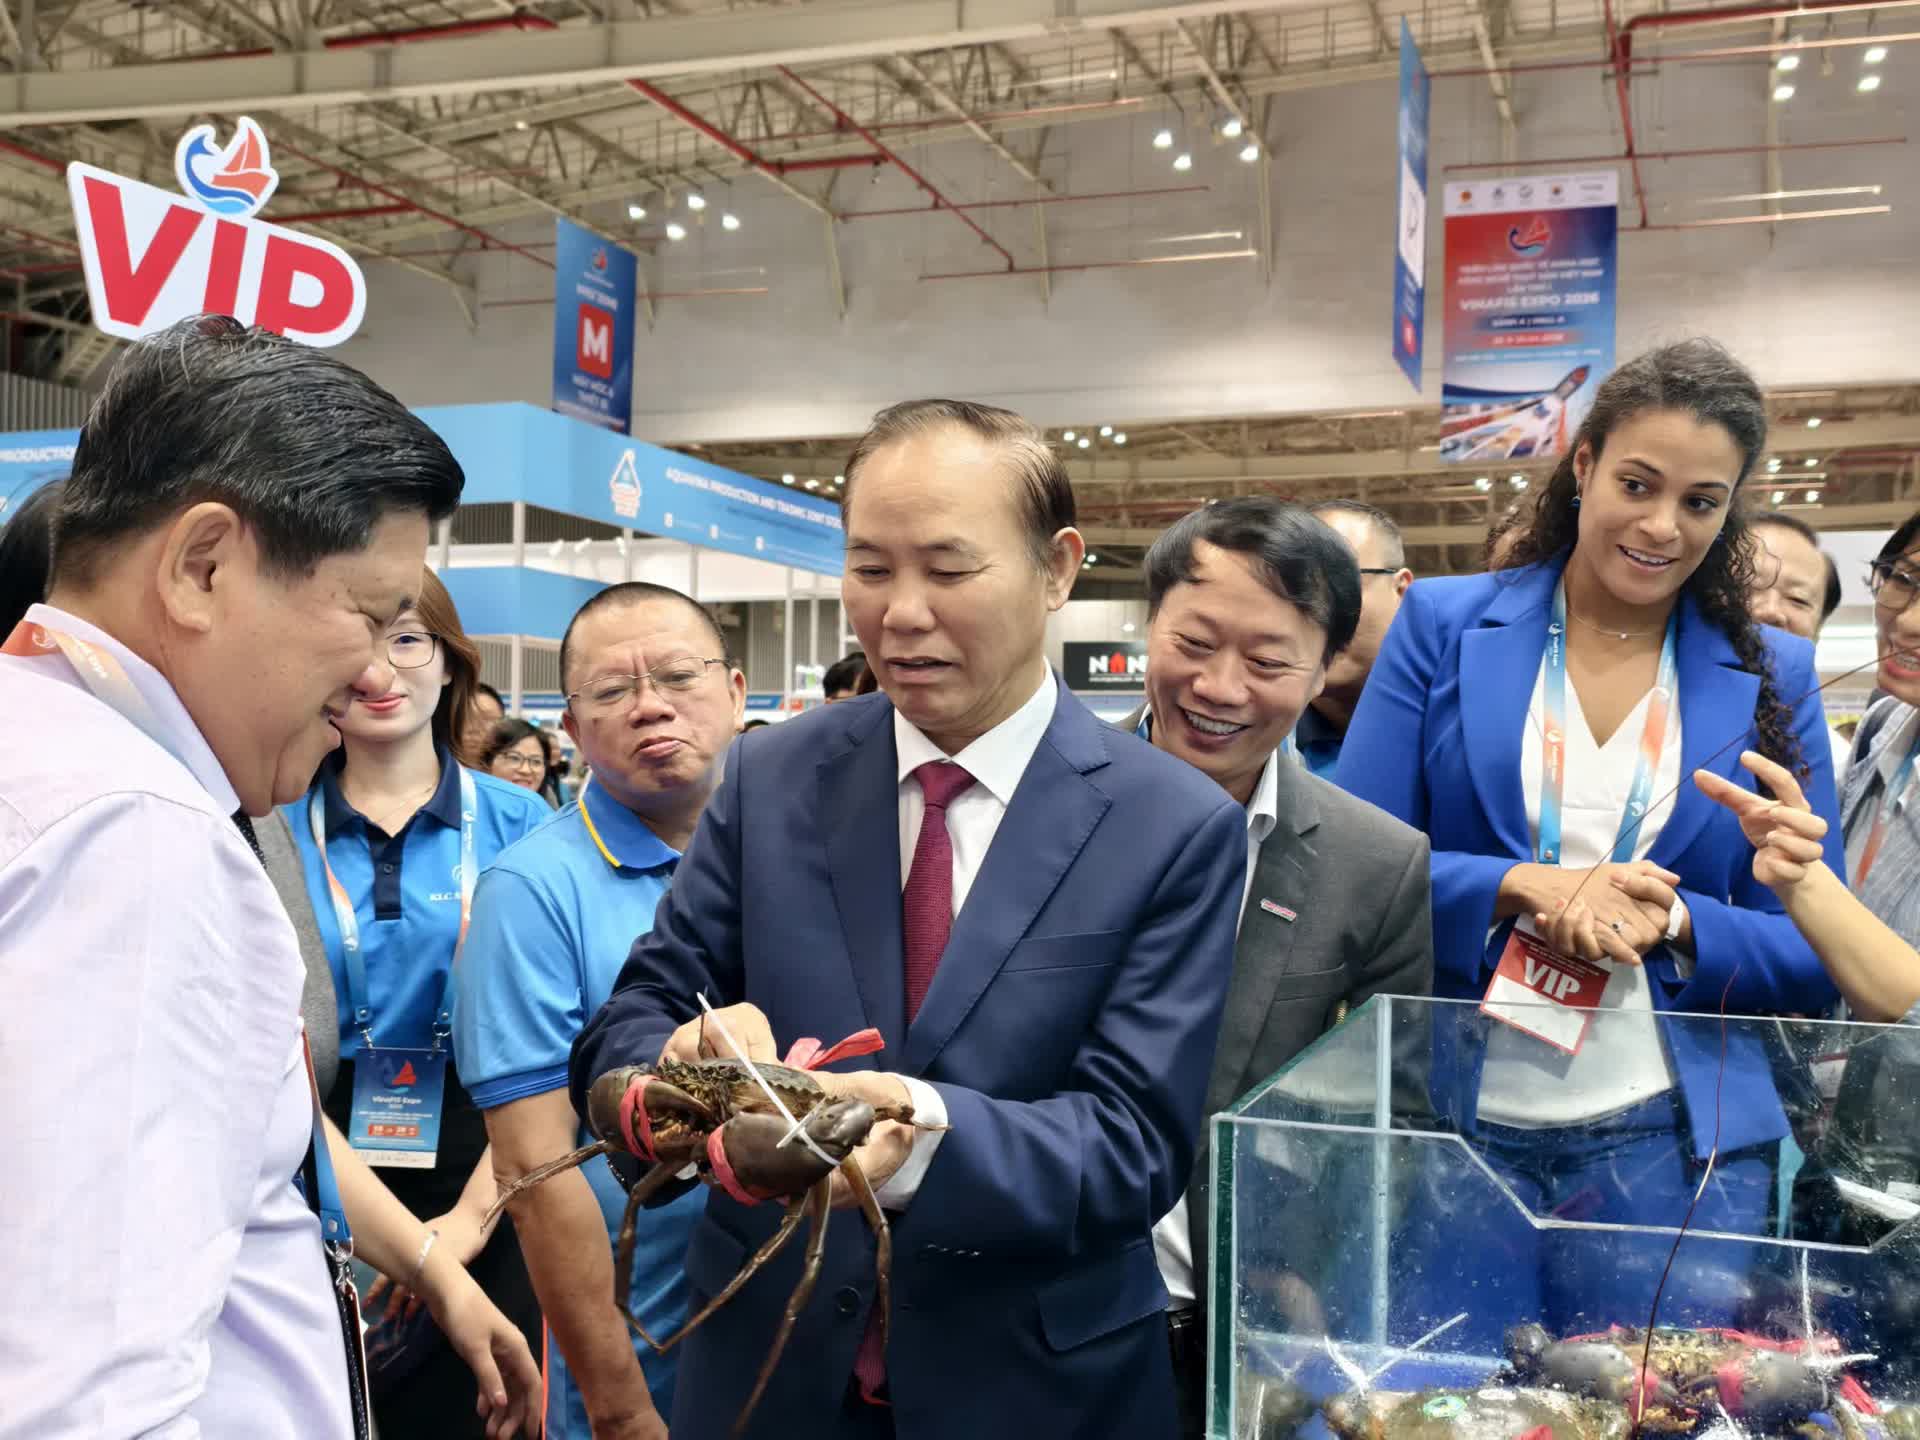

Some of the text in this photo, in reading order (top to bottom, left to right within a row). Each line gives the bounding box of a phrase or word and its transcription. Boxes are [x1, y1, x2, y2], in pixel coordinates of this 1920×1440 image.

[83, 175, 354, 337] VIP
[582, 316, 609, 364] M
[1524, 956, 1581, 1001] VIP
